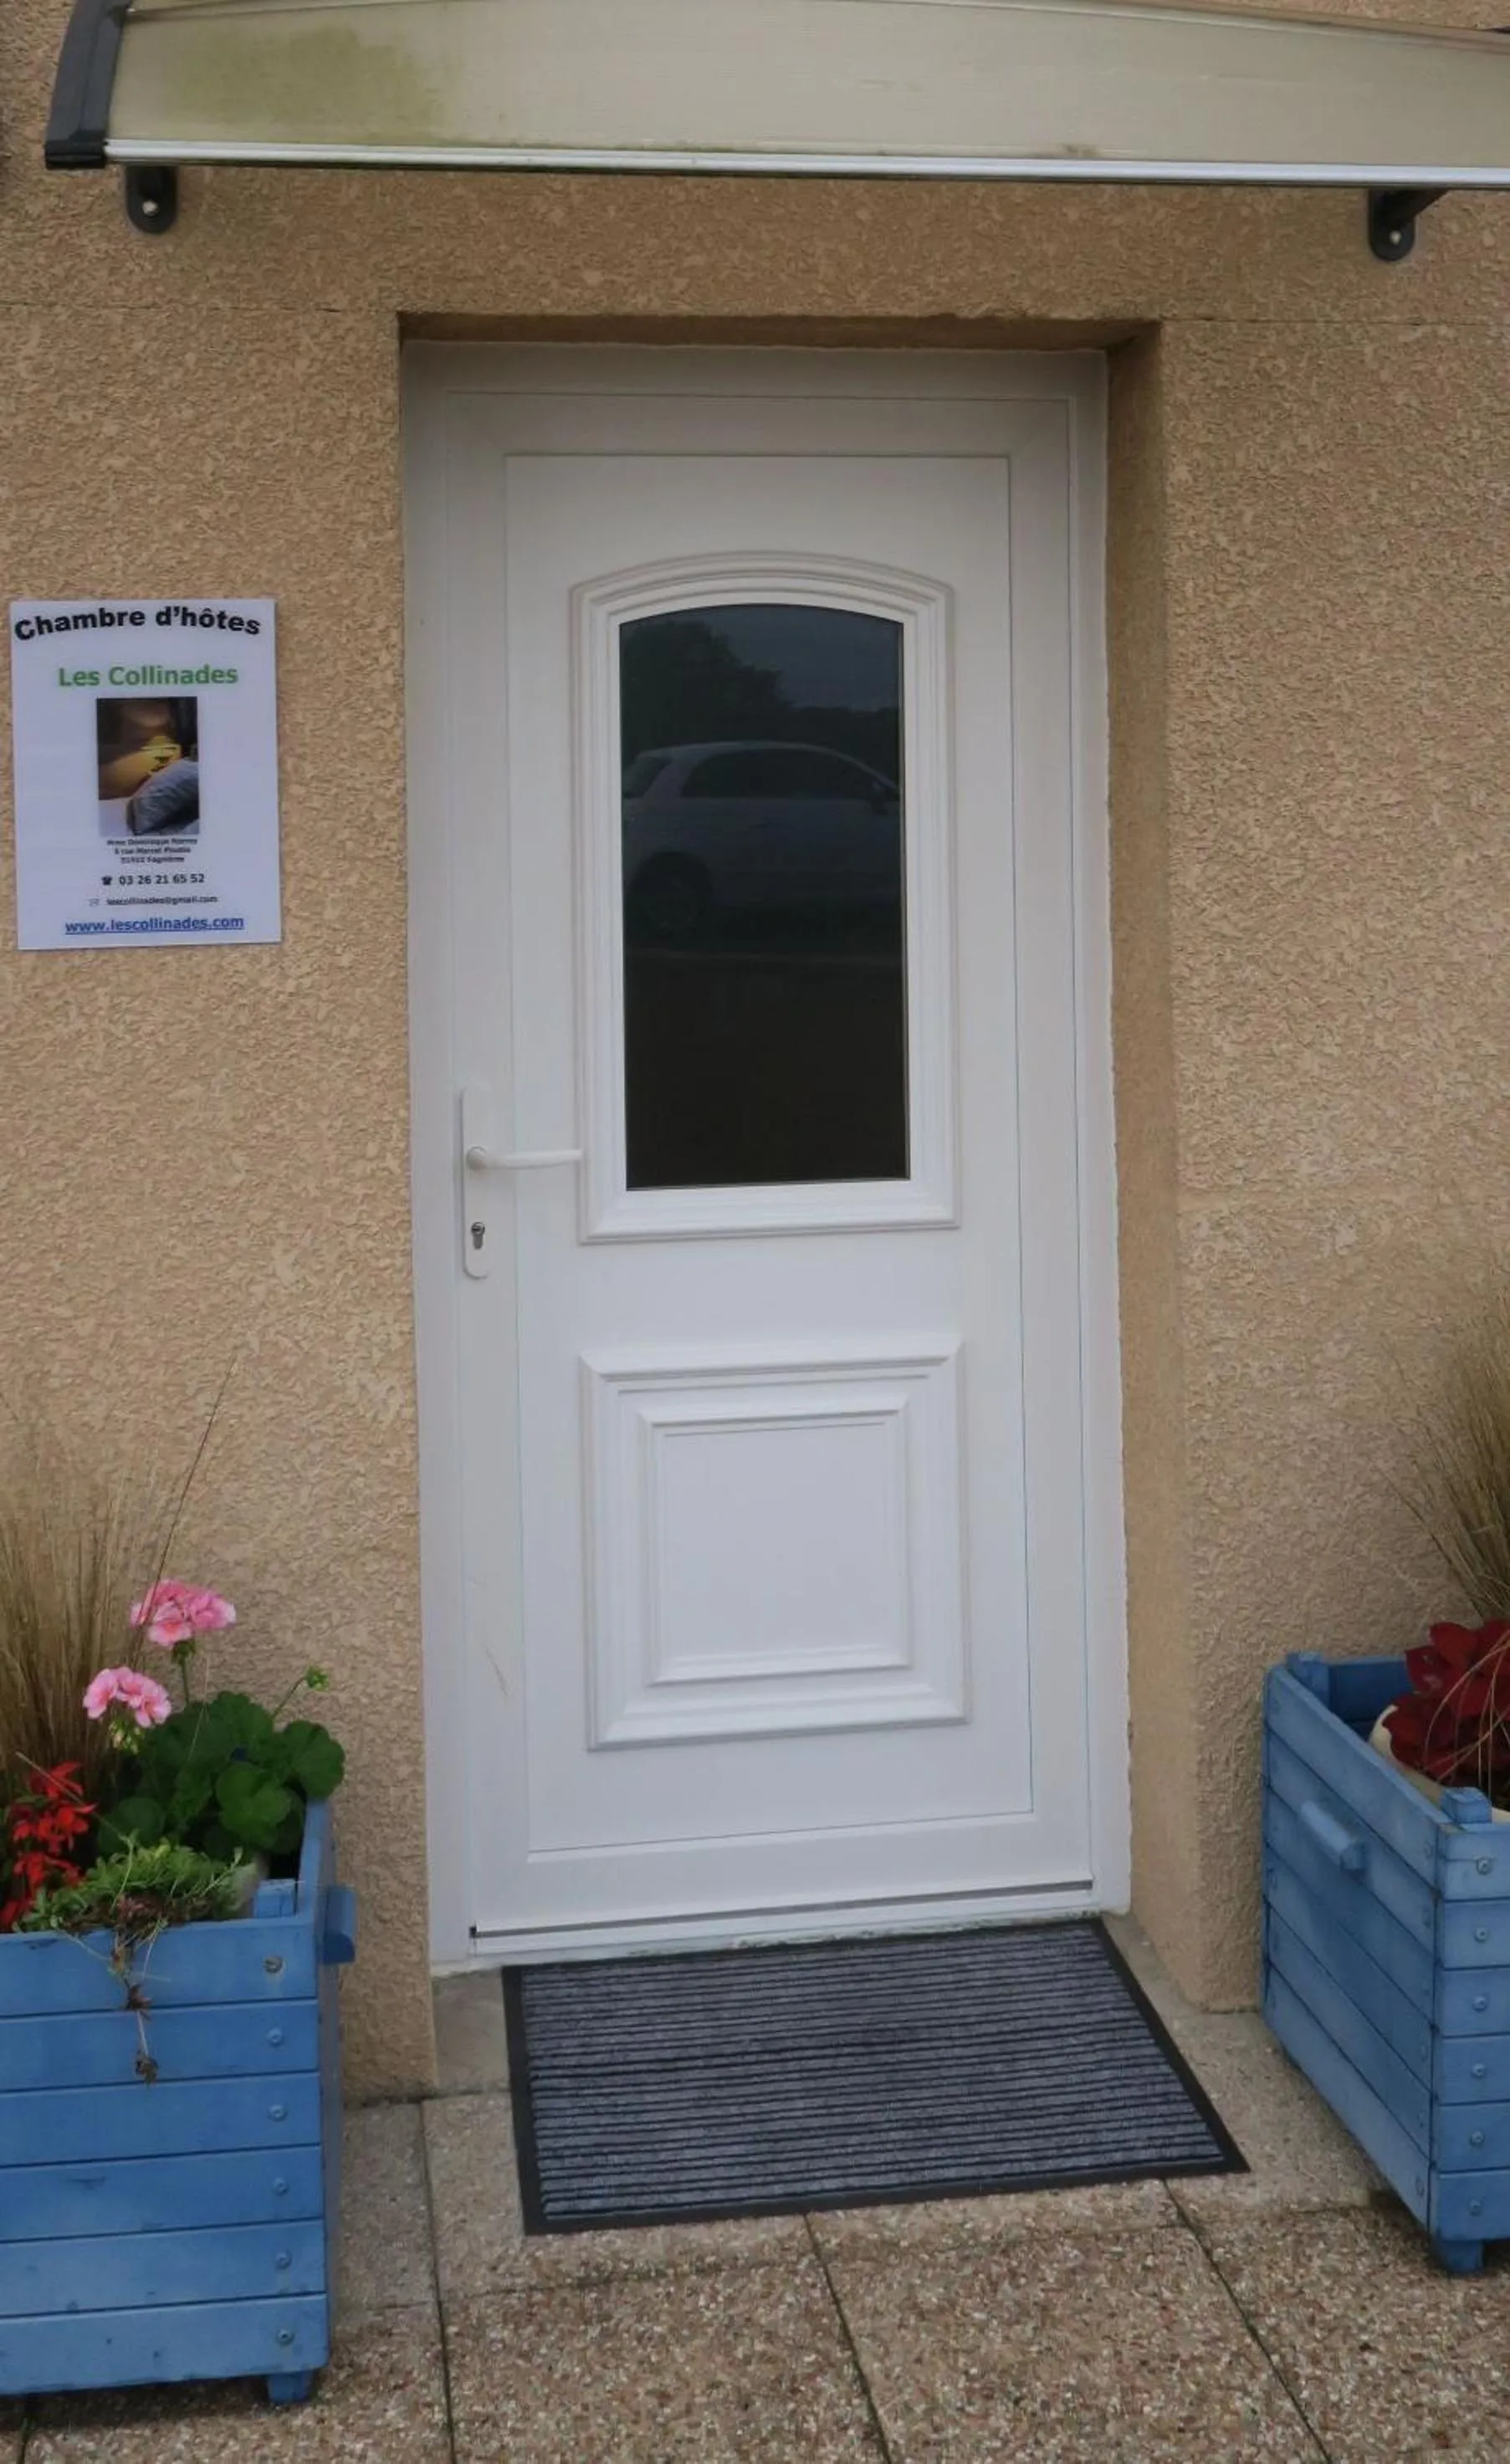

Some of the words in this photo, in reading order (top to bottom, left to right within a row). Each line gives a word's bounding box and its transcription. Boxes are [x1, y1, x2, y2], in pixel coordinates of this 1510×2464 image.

[14, 607, 146, 641] Chambre
[156, 606, 261, 636] d'hôtes
[59, 667, 100, 687] Les
[109, 664, 238, 686] Collinades
[119, 875, 134, 886] 03
[137, 875, 151, 885] 26
[156, 874, 168, 884] 21
[172, 873, 187, 883] 65
[190, 872, 205, 883] 52
[64, 916, 244, 934] www.lescollinades.com
